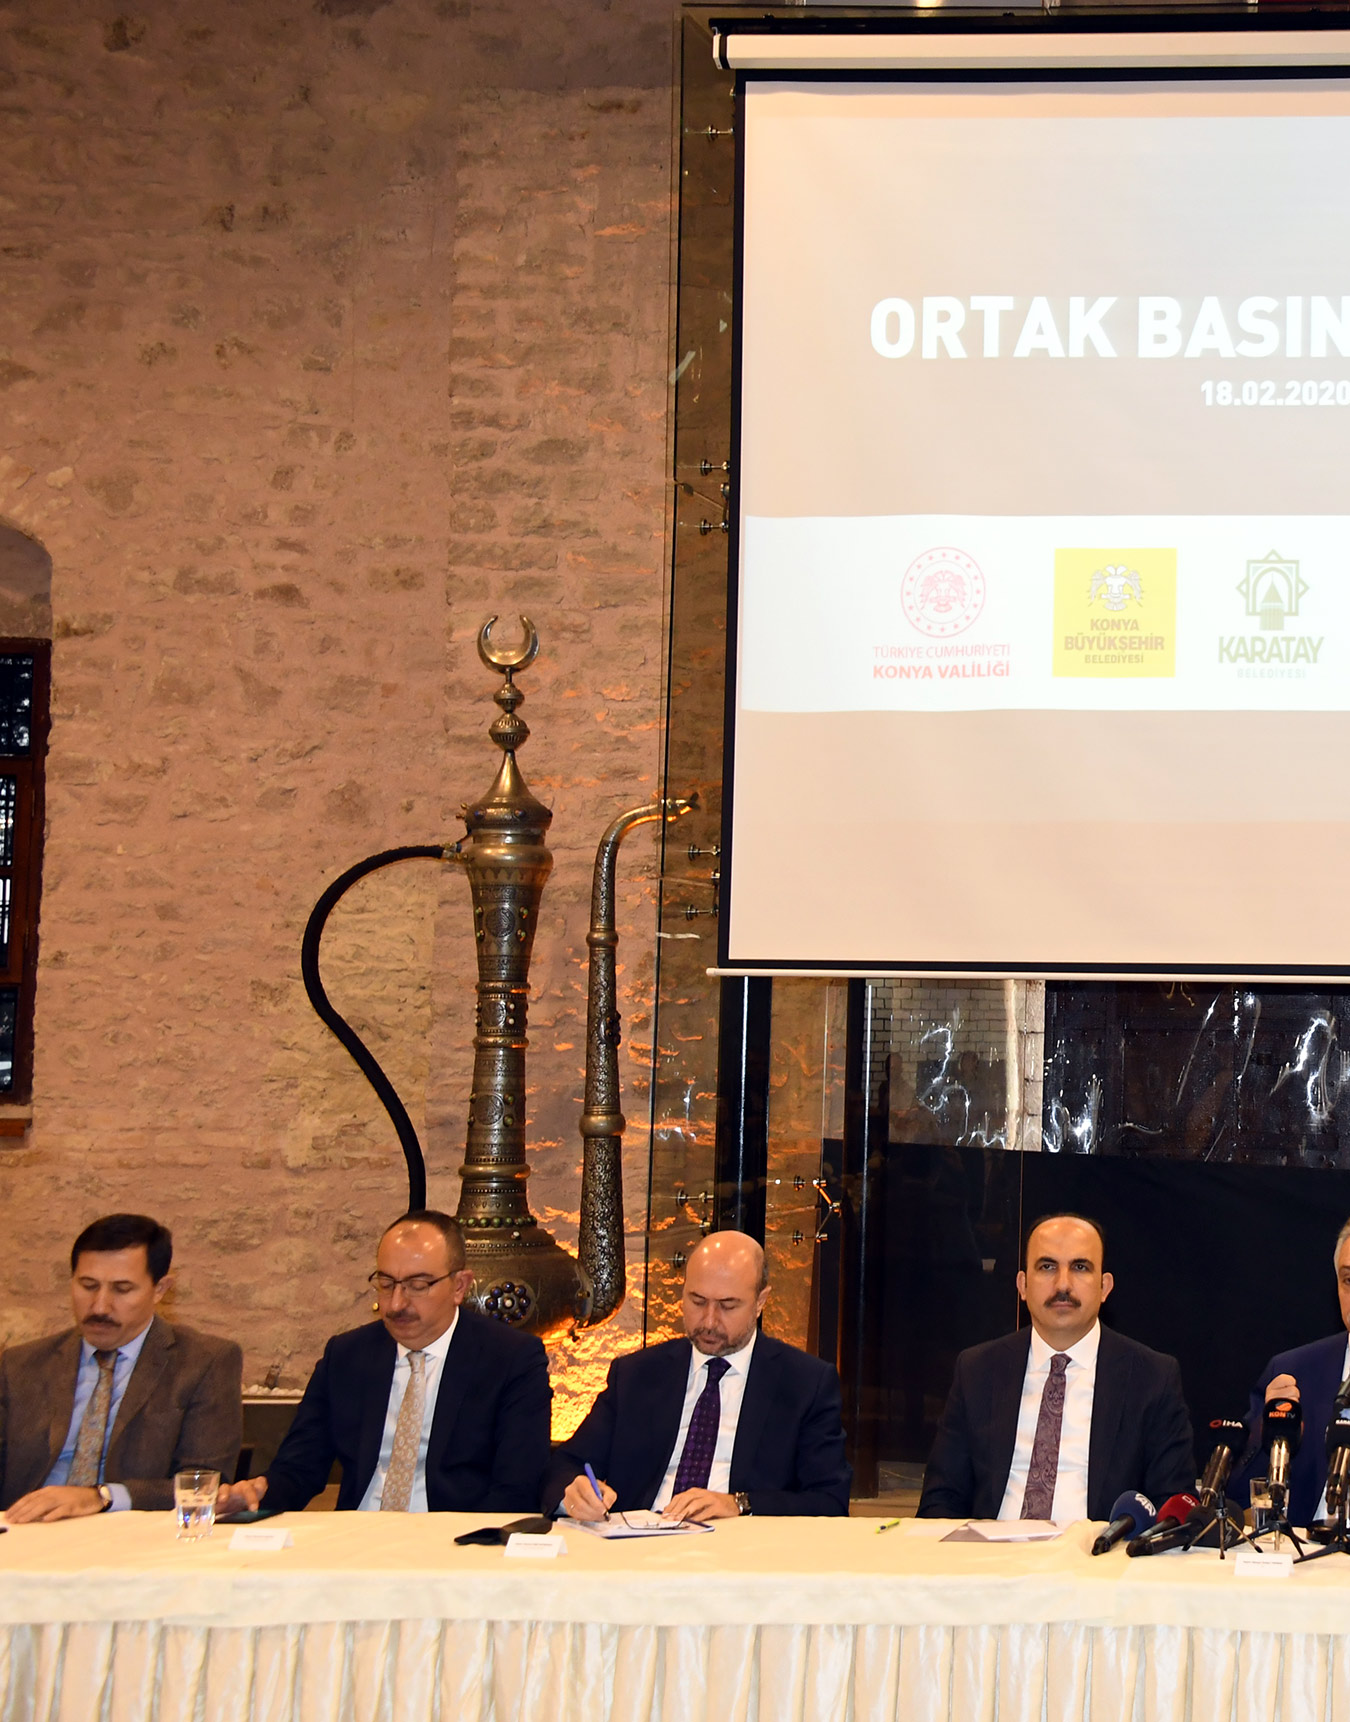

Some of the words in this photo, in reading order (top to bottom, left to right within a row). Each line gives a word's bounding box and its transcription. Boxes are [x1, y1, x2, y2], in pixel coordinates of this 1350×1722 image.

[870, 296, 1117, 360] ORTAK
[1090, 618, 1140, 631] KONYA
[1064, 632, 1165, 652] BÜYÜKŞEHİR
[1218, 636, 1325, 664] KARATAY
[873, 665, 933, 680] KONYA
[938, 660, 1010, 679] VALİLİĞİ
